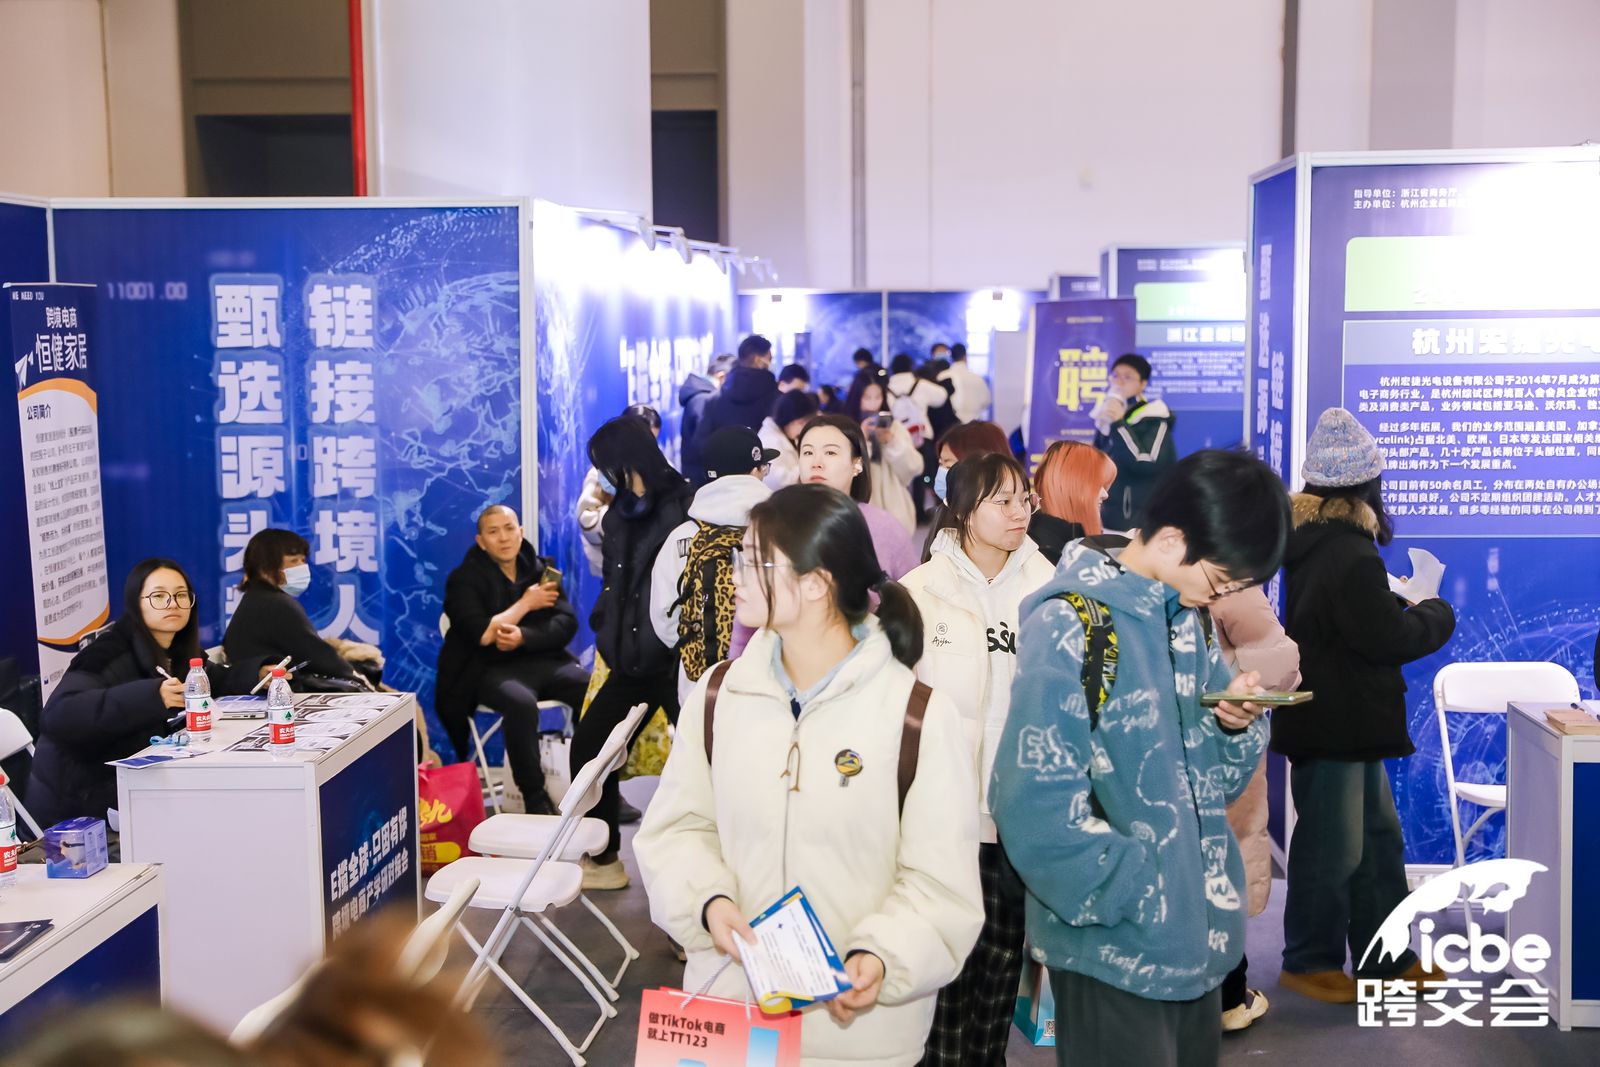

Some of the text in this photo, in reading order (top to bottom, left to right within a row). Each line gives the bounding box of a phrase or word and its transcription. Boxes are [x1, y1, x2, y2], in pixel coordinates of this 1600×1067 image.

[45, 306, 78, 329] 跨境电商
[35, 332, 88, 374] 恒健家居
[1359, 386, 1600, 400] 电子商务行业，是杭州综试区跨境百人会会员企业和
[26, 404, 52, 421] 公司简介
[1379, 421, 1600, 433] 经过多年拓展，我们的业务范围涵盖美国、加拿
[214, 284, 286, 632] 甄选源头
[308, 284, 381, 646] 链接跨境人
[647, 1027, 708, 1048] 就上TT123
